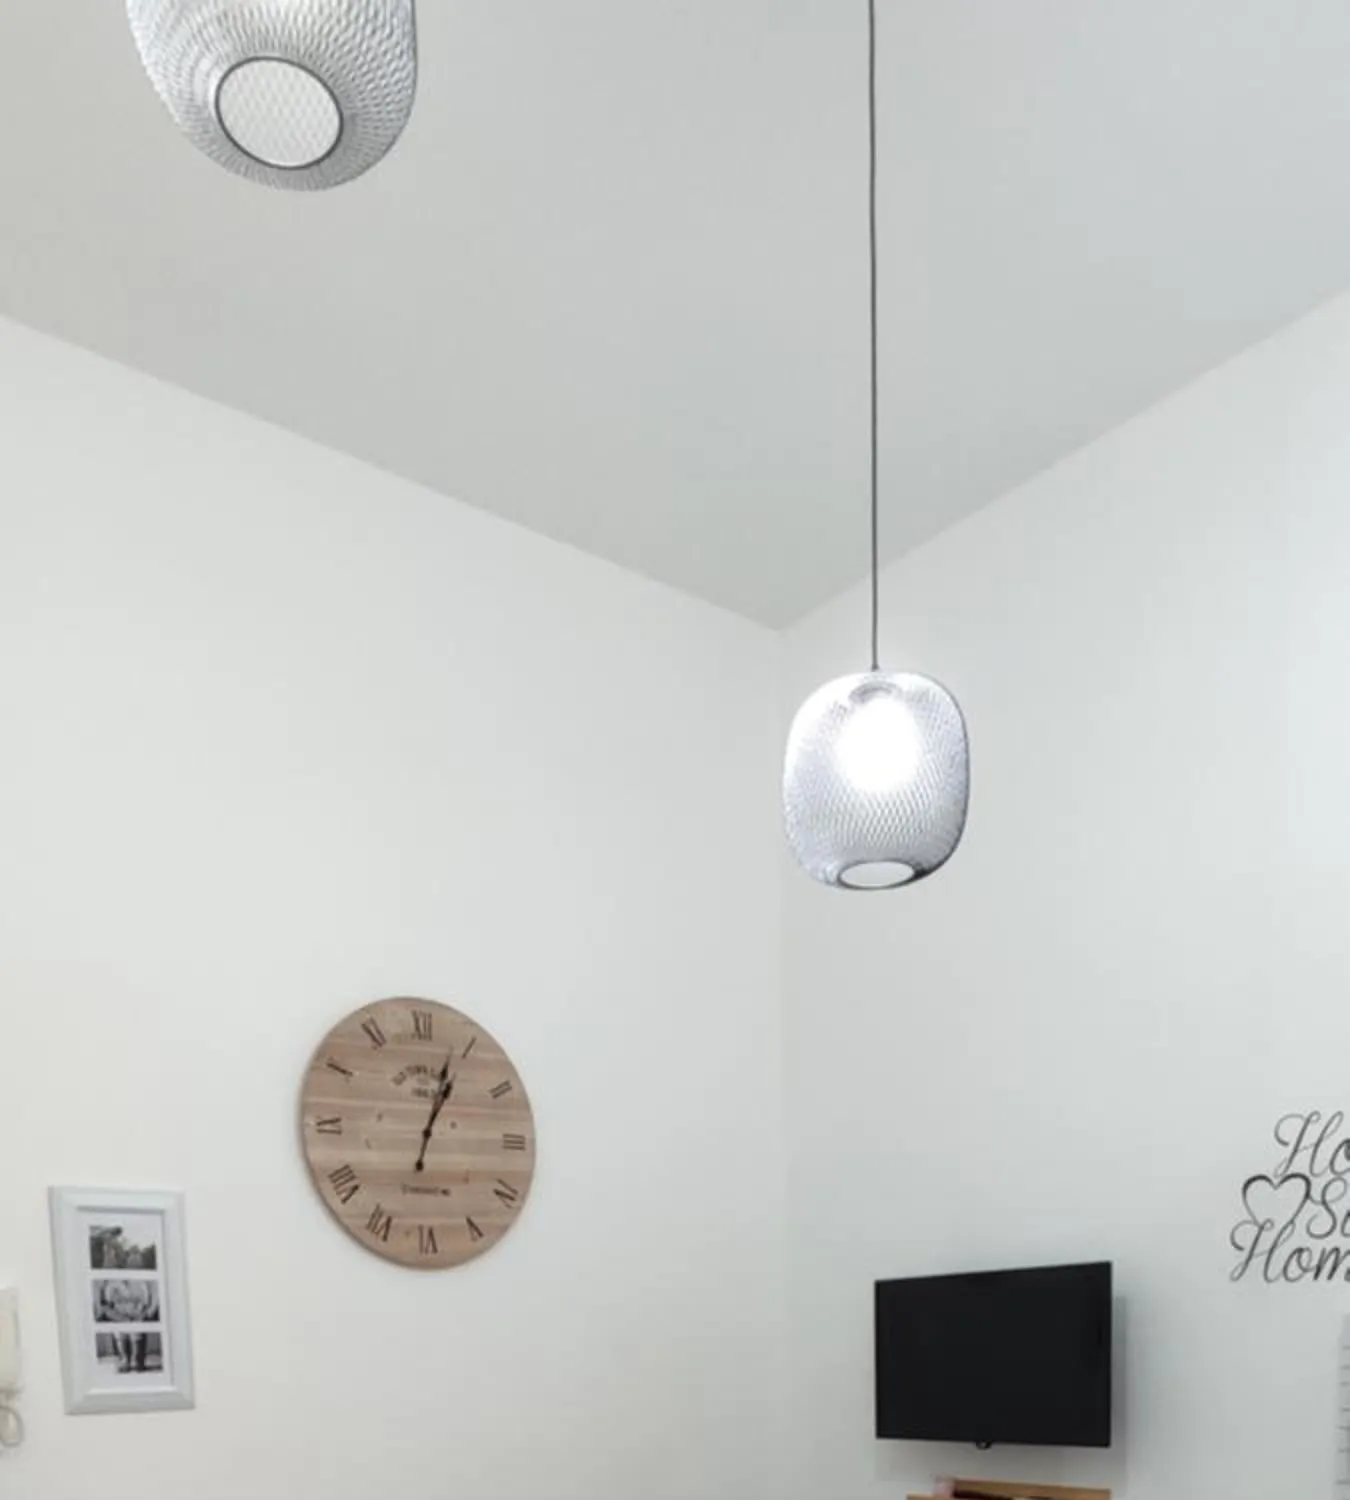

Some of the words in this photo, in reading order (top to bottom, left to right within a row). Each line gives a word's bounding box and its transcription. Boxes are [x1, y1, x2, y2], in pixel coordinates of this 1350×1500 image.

[411, 1010, 432, 1041] XII
[488, 1080, 513, 1099] II
[502, 1133, 526, 1150] III
